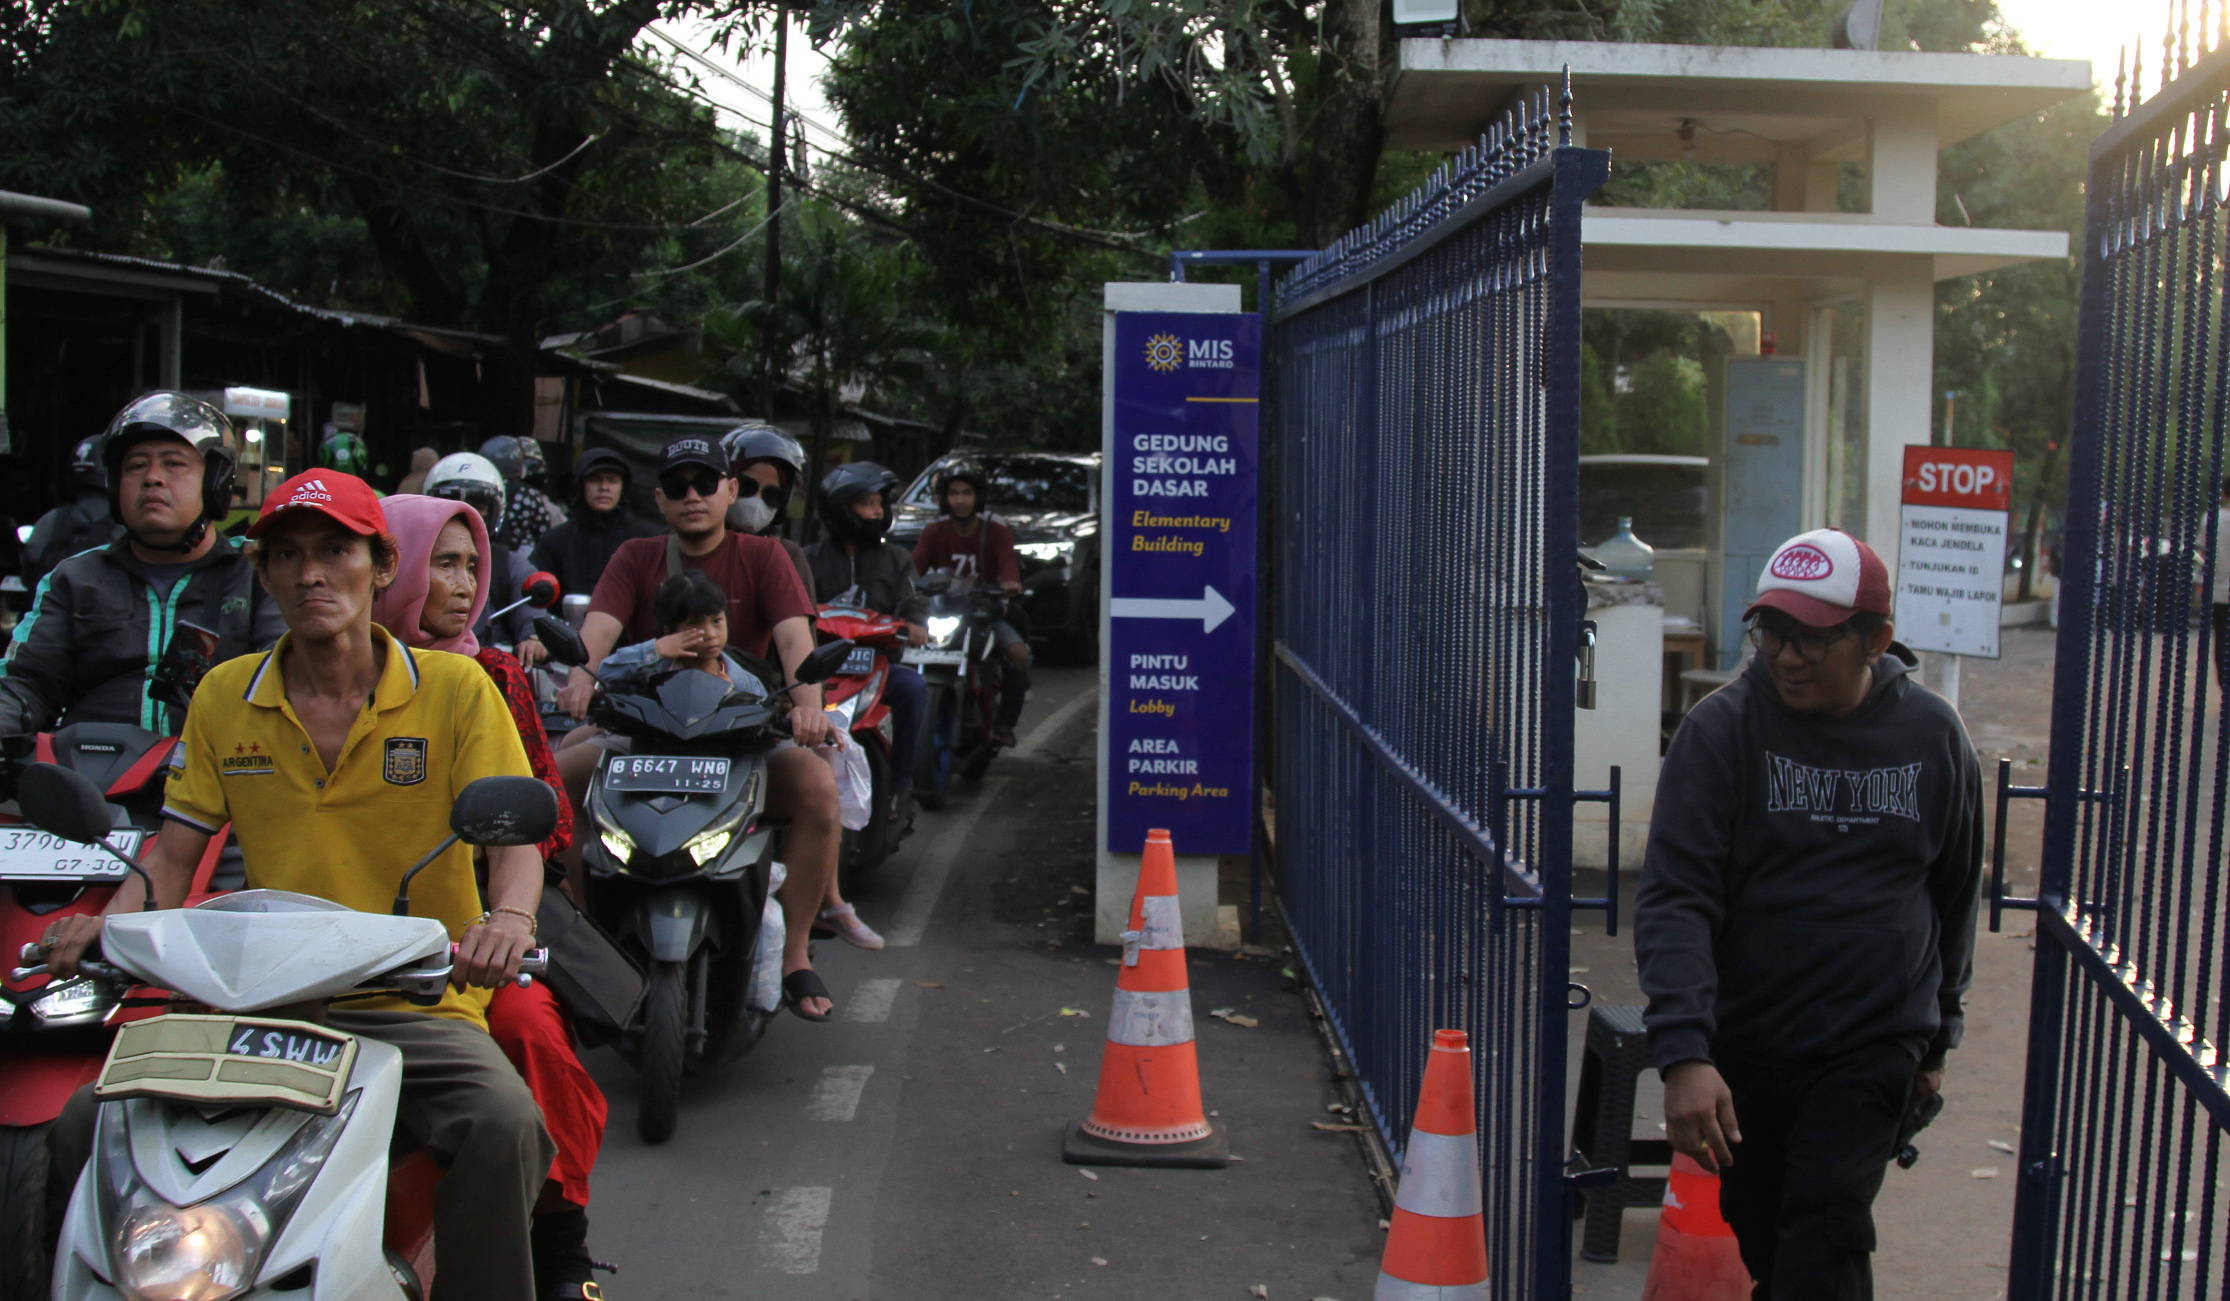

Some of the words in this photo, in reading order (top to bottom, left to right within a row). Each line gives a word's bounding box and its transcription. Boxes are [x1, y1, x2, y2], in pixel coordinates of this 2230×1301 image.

[1188, 339, 1234, 360] MIS
[1188, 360, 1234, 369] BINTARO
[1133, 434, 1229, 452] GEDUNG
[1132, 457, 1236, 475] SEKOLAH
[1918, 462, 1995, 495] STOP
[1132, 479, 1209, 497] DASAR
[290, 491, 332, 502] adidas
[1132, 510, 1231, 533] Elementary
[1911, 519, 1948, 532] MOHON
[1951, 522, 2002, 535] MEMBUKA
[1132, 535, 1204, 556] Building
[1911, 536, 1938, 548] KACA
[1940, 538, 1984, 551] JENDELA
[1909, 560, 1966, 574] TUNJUKAN
[1968, 565, 1980, 575] ID
[1907, 584, 1934, 596] TAMU
[1936, 587, 1965, 599] WAJIB
[1968, 590, 1998, 602] LAPOR
[1130, 654, 1188, 670] PINTU
[1129, 675, 1200, 690] MASUK
[1129, 699, 1175, 717] Lobby
[80, 744, 116, 752] HONDA
[1128, 739, 1180, 754] AREA
[222, 755, 274, 768] ARGENTINA
[612, 760, 626, 774] B
[632, 759, 678, 773] 6647
[1128, 759, 1199, 775] PARKIR
[1128, 781, 1188, 800] Parking
[1190, 782, 1229, 797] Area
[1765, 750, 1841, 812] NEW
[1844, 762, 1922, 822] YORK
